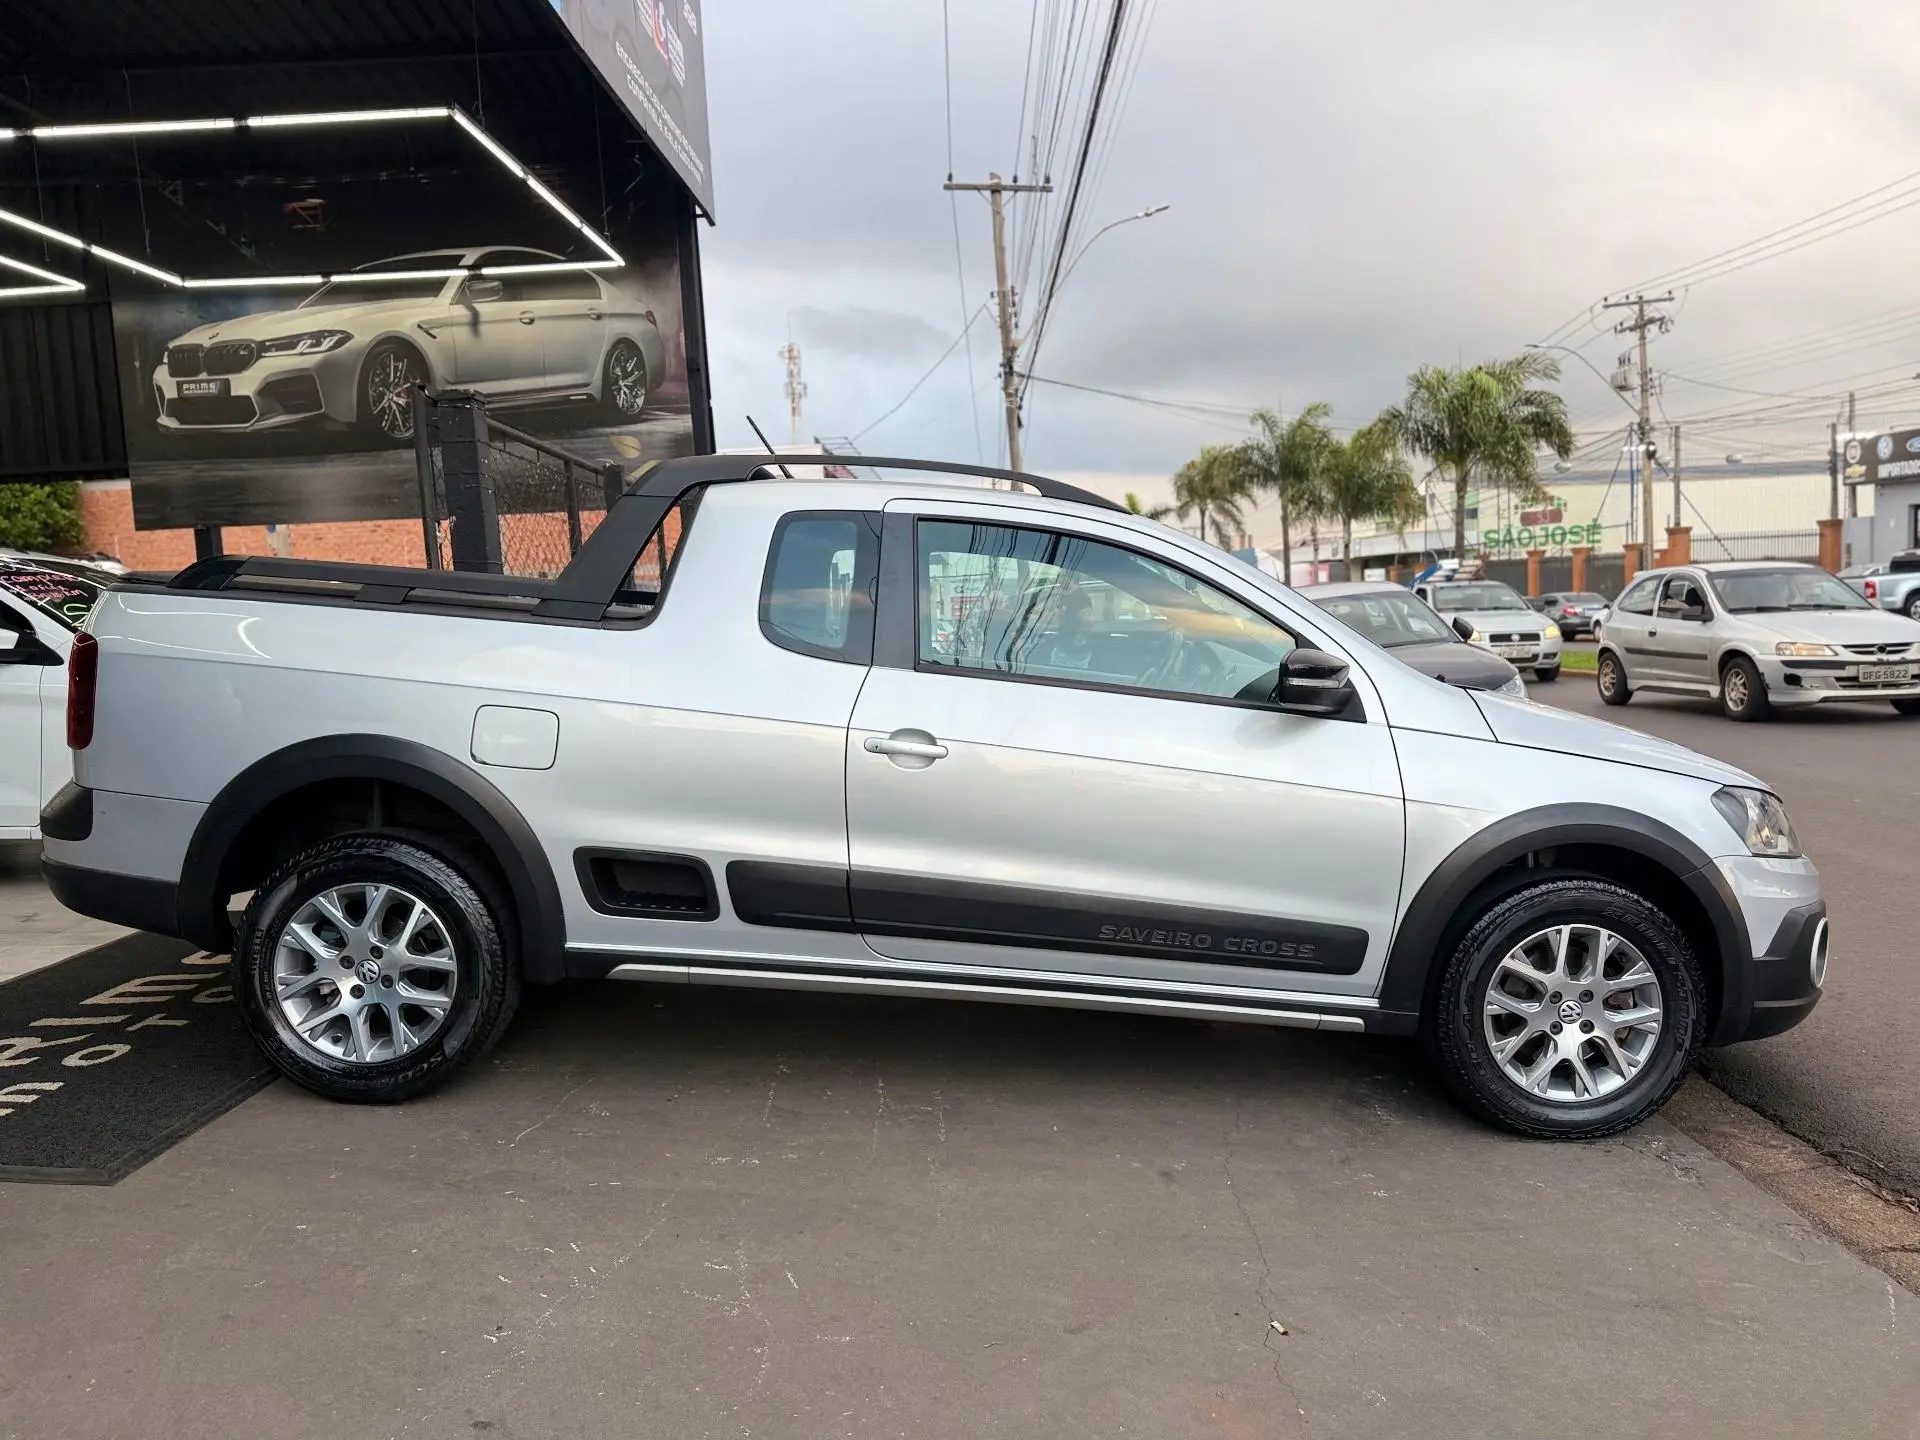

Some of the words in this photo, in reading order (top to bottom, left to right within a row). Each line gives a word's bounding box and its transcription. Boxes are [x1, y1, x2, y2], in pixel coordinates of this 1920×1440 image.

[182, 382, 216, 391] PRIME
[1483, 524, 1533, 549] SÃO
[1538, 518, 1602, 546] JOSÉ
[1098, 924, 1213, 948] SAVEIRO
[1223, 935, 1317, 958] CROSS
